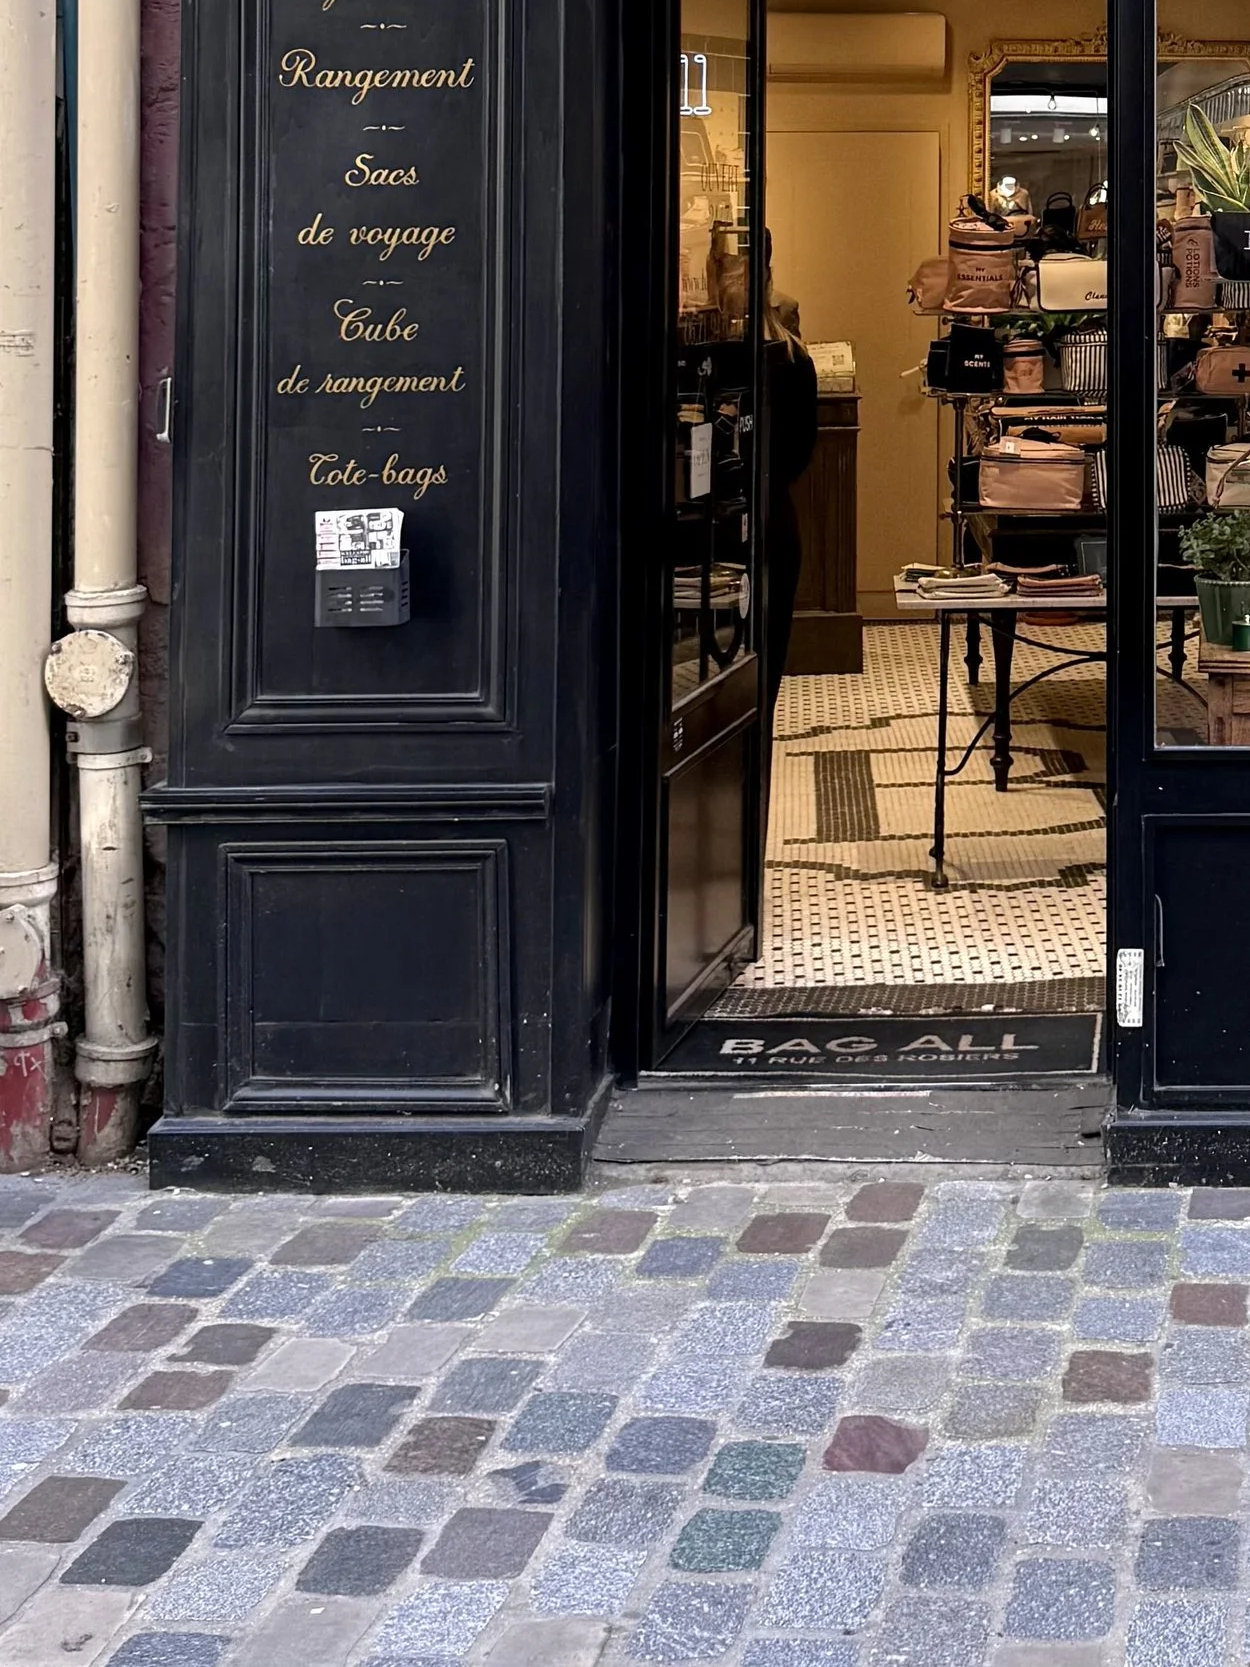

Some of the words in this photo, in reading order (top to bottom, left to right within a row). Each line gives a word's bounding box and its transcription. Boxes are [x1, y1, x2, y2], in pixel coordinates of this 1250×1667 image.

[278, 48, 476, 106] Rangement
[344, 153, 420, 187] Sacs
[298, 212, 335, 245] de
[348, 225, 456, 261] voyage
[956, 274, 1003, 282] ESSENTIALS
[1184, 247, 1193, 288] POTIONS
[1192, 247, 1201, 288] LOTIONS
[333, 298, 420, 342] Cube
[276, 364, 309, 394] de
[315, 366, 466, 409] rangement
[308, 453, 449, 500] Tote-bags
[719, 1036, 878, 1054] BAG
[896, 1034, 1039, 1051] ALL
[768, 1055, 827, 1064] RUE
[835, 1054, 888, 1063] DES
[898, 1052, 1019, 1063] ROSIERS
